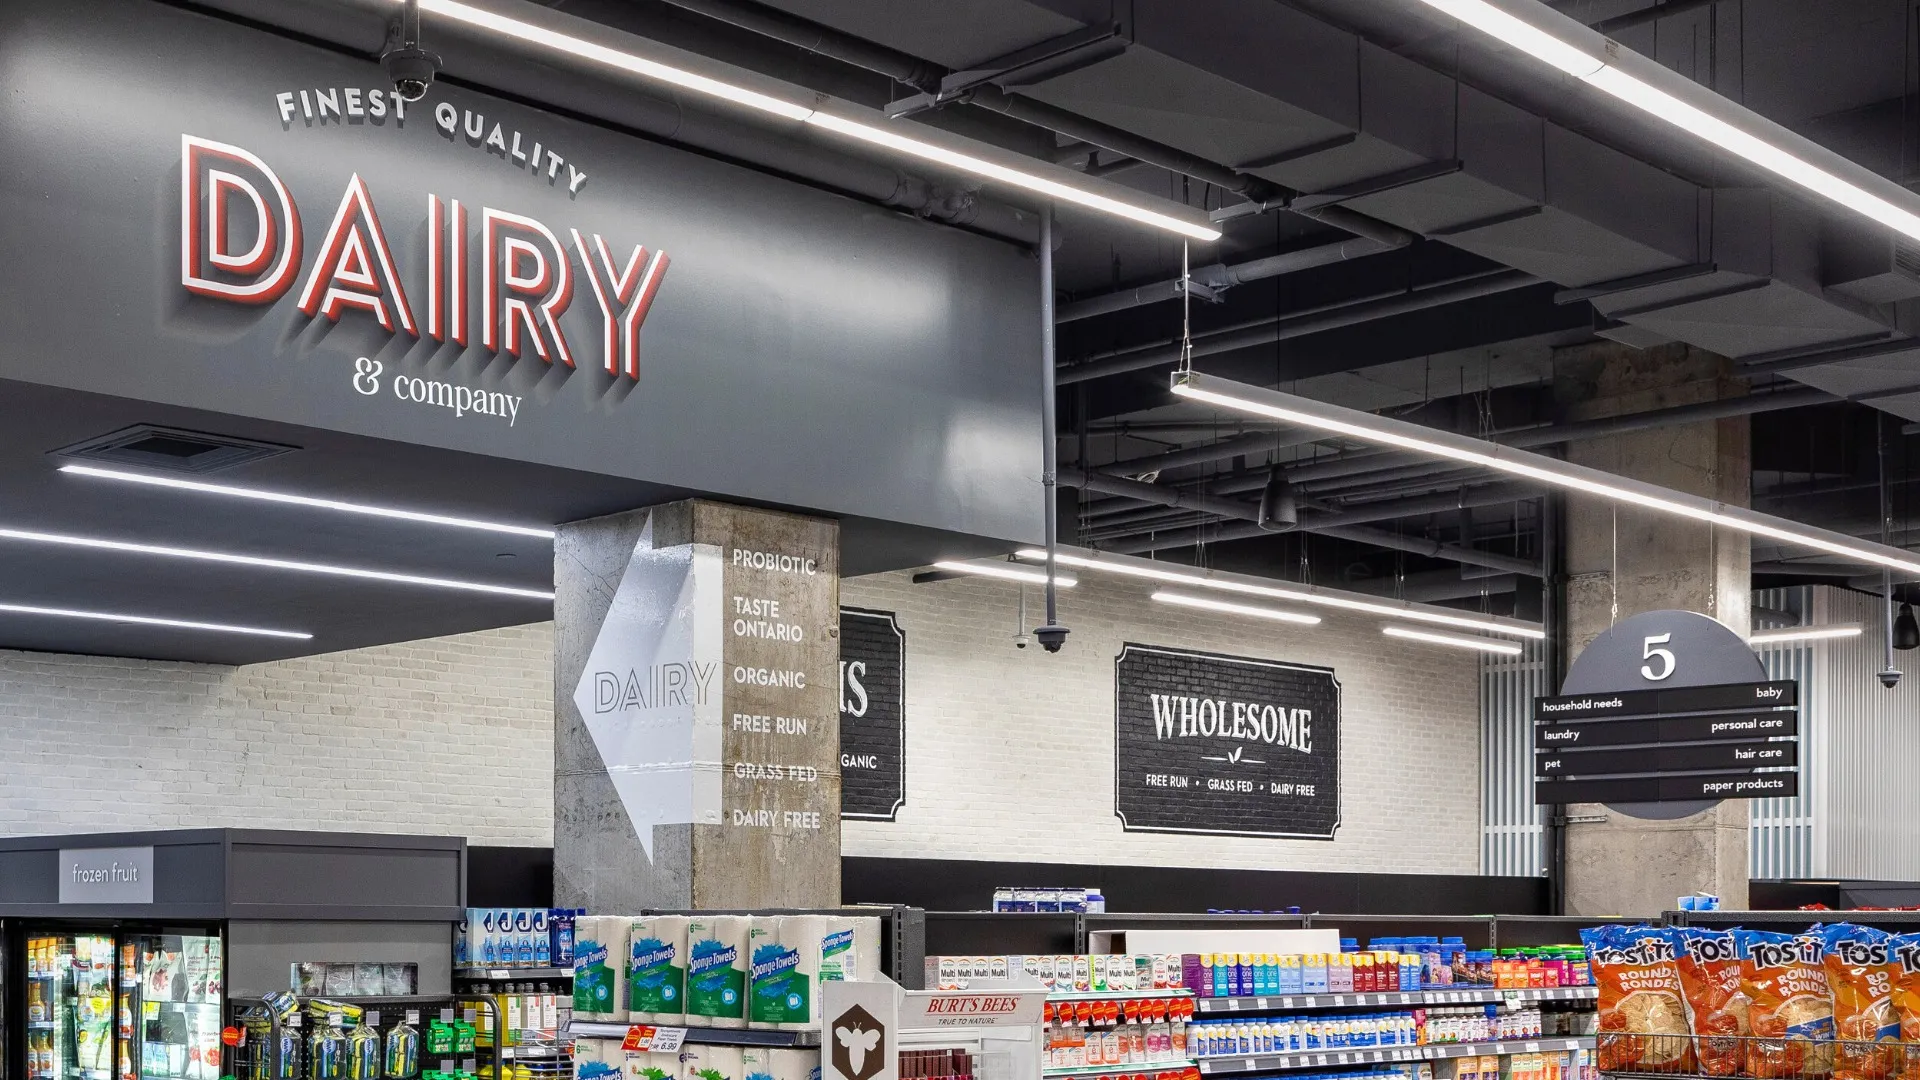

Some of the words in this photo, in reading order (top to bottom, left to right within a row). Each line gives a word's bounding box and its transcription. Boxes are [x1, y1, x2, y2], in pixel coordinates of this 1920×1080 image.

[276, 87, 406, 122] FINEST
[435, 102, 588, 197] QUALITY
[181, 133, 671, 381] DAIRY
[353, 357, 384, 395] &
[394, 373, 522, 427] company
[733, 548, 816, 576] PROBIOTIC
[733, 596, 779, 618] TASTE
[733, 619, 803, 642] ONTARIO
[1640, 632, 1676, 681] 5
[734, 666, 806, 689] ORGANIC
[595, 660, 718, 714] DAIRY
[1756, 687, 1783, 700] baby
[1543, 698, 1592, 712] household
[1593, 697, 1623, 709] needs
[733, 713, 770, 734] FREE
[776, 715, 807, 736] RUN
[1150, 693, 1312, 754] WHOLESOME
[1711, 718, 1757, 733] personal
[1759, 719, 1783, 729] care
[1544, 729, 1580, 742] laundry
[841, 754, 877, 769] GANIC
[1735, 748, 1756, 760] hair
[1758, 749, 1782, 759] care
[734, 761, 784, 781] GRASS
[788, 764, 818, 783] FED
[1545, 758, 1561, 770] pet
[1146, 774, 1167, 787] FREE
[1170, 775, 1188, 788] RUN
[1207, 778, 1235, 792] GRASS
[1237, 780, 1253, 792] FED
[1271, 782, 1294, 795] DAIRY
[1296, 784, 1316, 796] FREE
[1703, 780, 1734, 794] paper
[1736, 778, 1784, 791] products
[733, 809, 777, 827] DAIRY
[783, 811, 820, 829] FREE
[72, 863, 109, 883] frozen
[112, 861, 138, 882] fruit
[1747, 936, 1825, 971] TOSTIT
[1835, 938, 1888, 967] TOS
[941, 969, 956, 978] Multi
[958, 969, 972, 977] Multi
[974, 969, 988, 977] Multi
[991, 968, 1006, 977] Multi
[1040, 971, 1054, 979] Multi
[1618, 967, 1678, 981] ROUNDS
[1777, 967, 1827, 985] ROUND
[1620, 979, 1680, 992] RONDES
[927, 997, 980, 1013] BURT'S
[981, 997, 1019, 1012] BEES
[660, 1042, 677, 1050] 6.99
